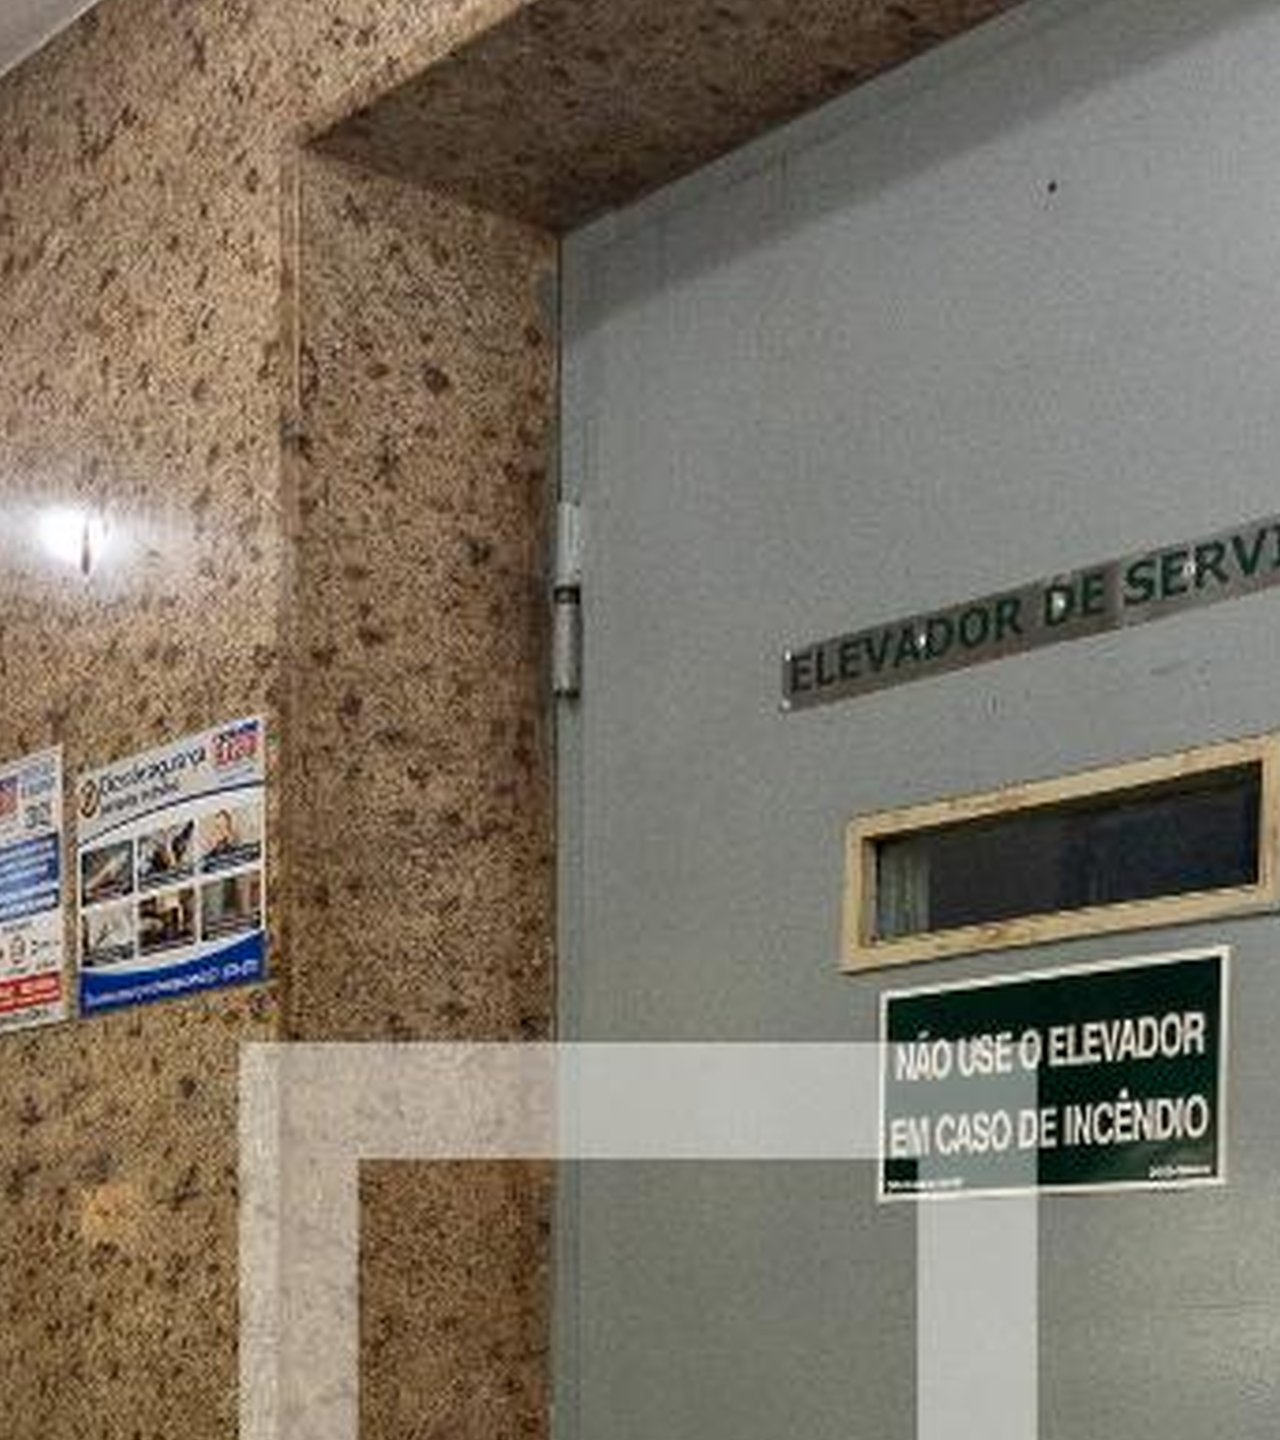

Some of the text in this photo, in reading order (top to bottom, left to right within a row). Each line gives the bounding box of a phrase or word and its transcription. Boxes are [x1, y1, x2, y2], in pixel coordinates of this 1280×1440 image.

[787, 600, 1021, 695] ELEVADOR
[1043, 572, 1107, 627] DE
[956, 1032, 1014, 1077] USE
[1019, 1029, 1042, 1071] O
[1047, 1012, 1206, 1068] ELEVADOR
[888, 1087, 1209, 1159] EM CASO DE INCÊNDIO
